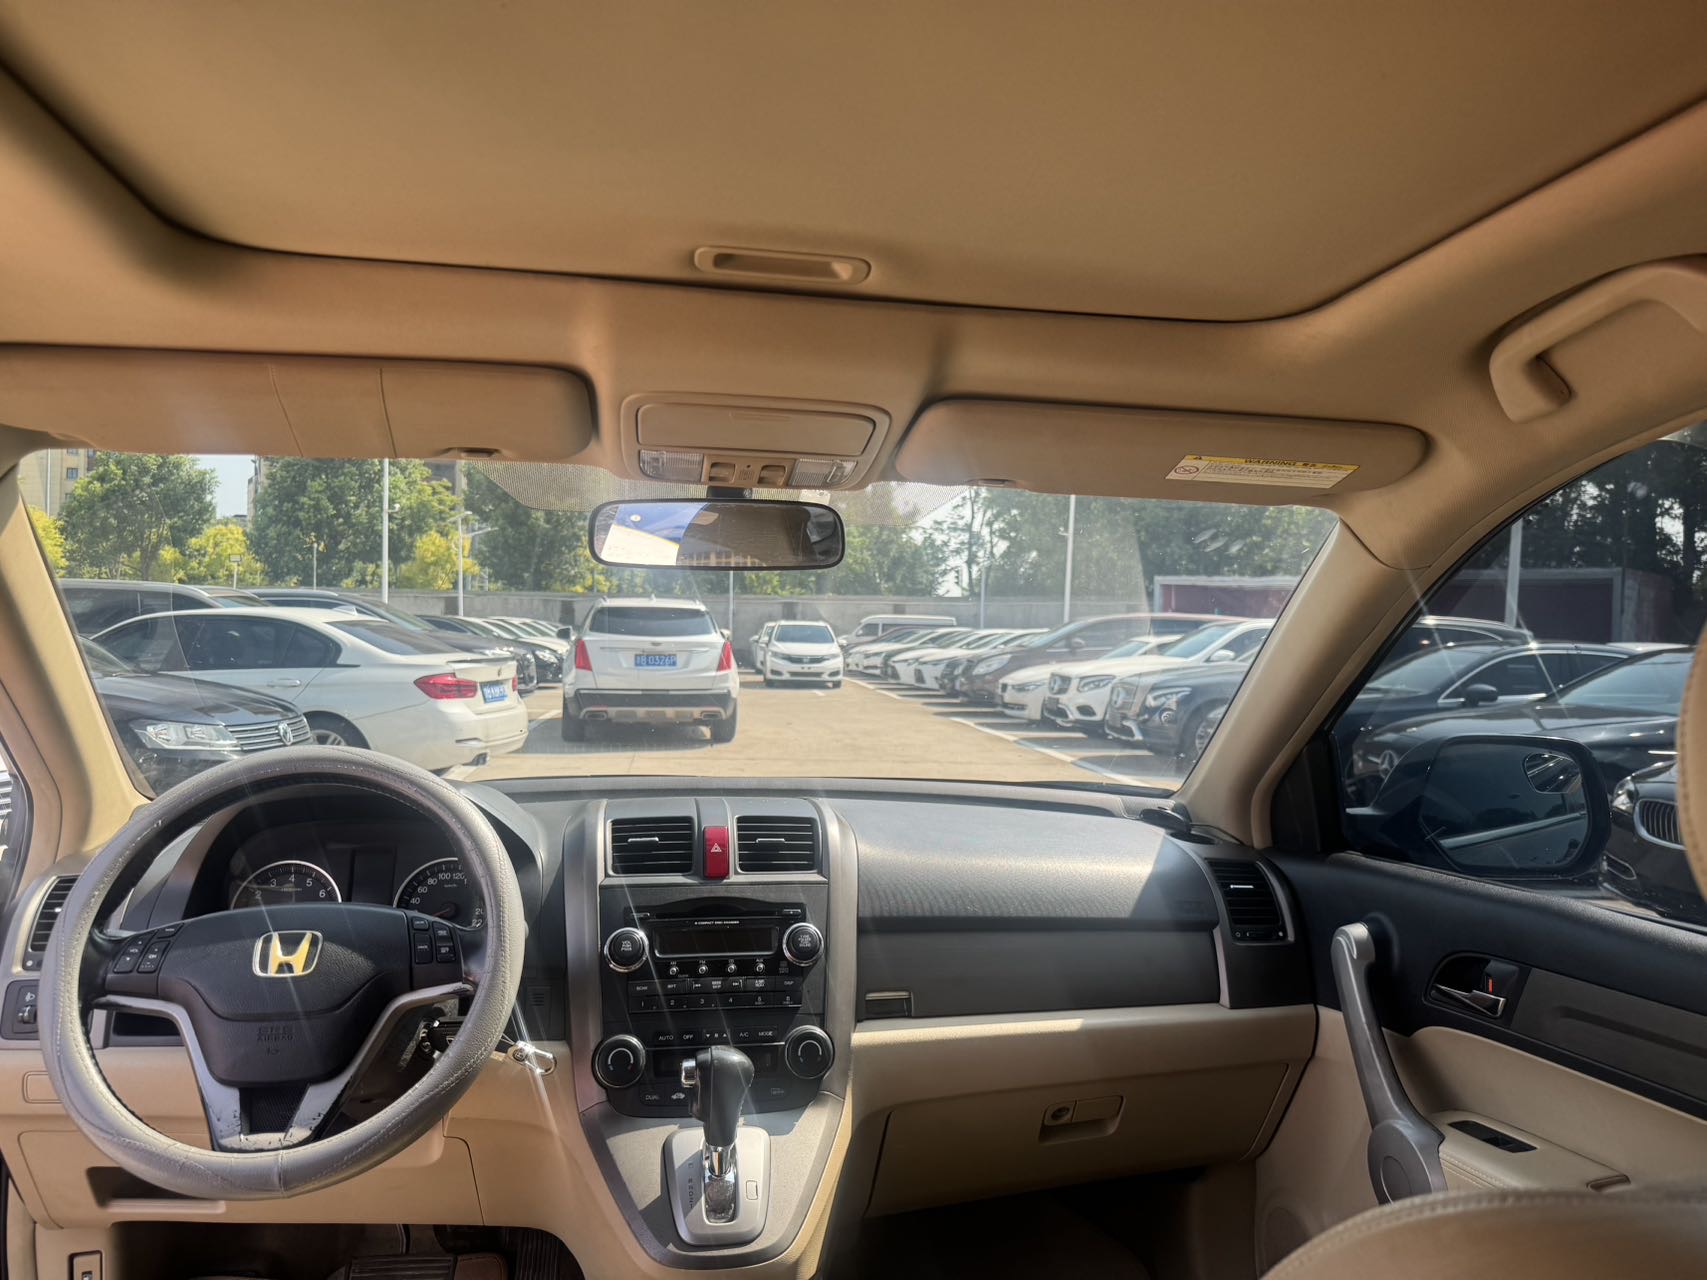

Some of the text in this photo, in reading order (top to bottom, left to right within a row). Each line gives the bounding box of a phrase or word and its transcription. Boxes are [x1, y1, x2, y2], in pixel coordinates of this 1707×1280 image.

[1245, 458, 1297, 467] WARNING
[288, 874, 295, 882] 4
[438, 872, 451, 880] 100
[270, 879, 277, 887] 3
[306, 878, 313, 887] 5
[427, 878, 438, 886] 80
[319, 889, 326, 898] 6
[417, 886, 428, 894] 60
[255, 890, 262, 899] 2
[410, 897, 421, 905] 40
